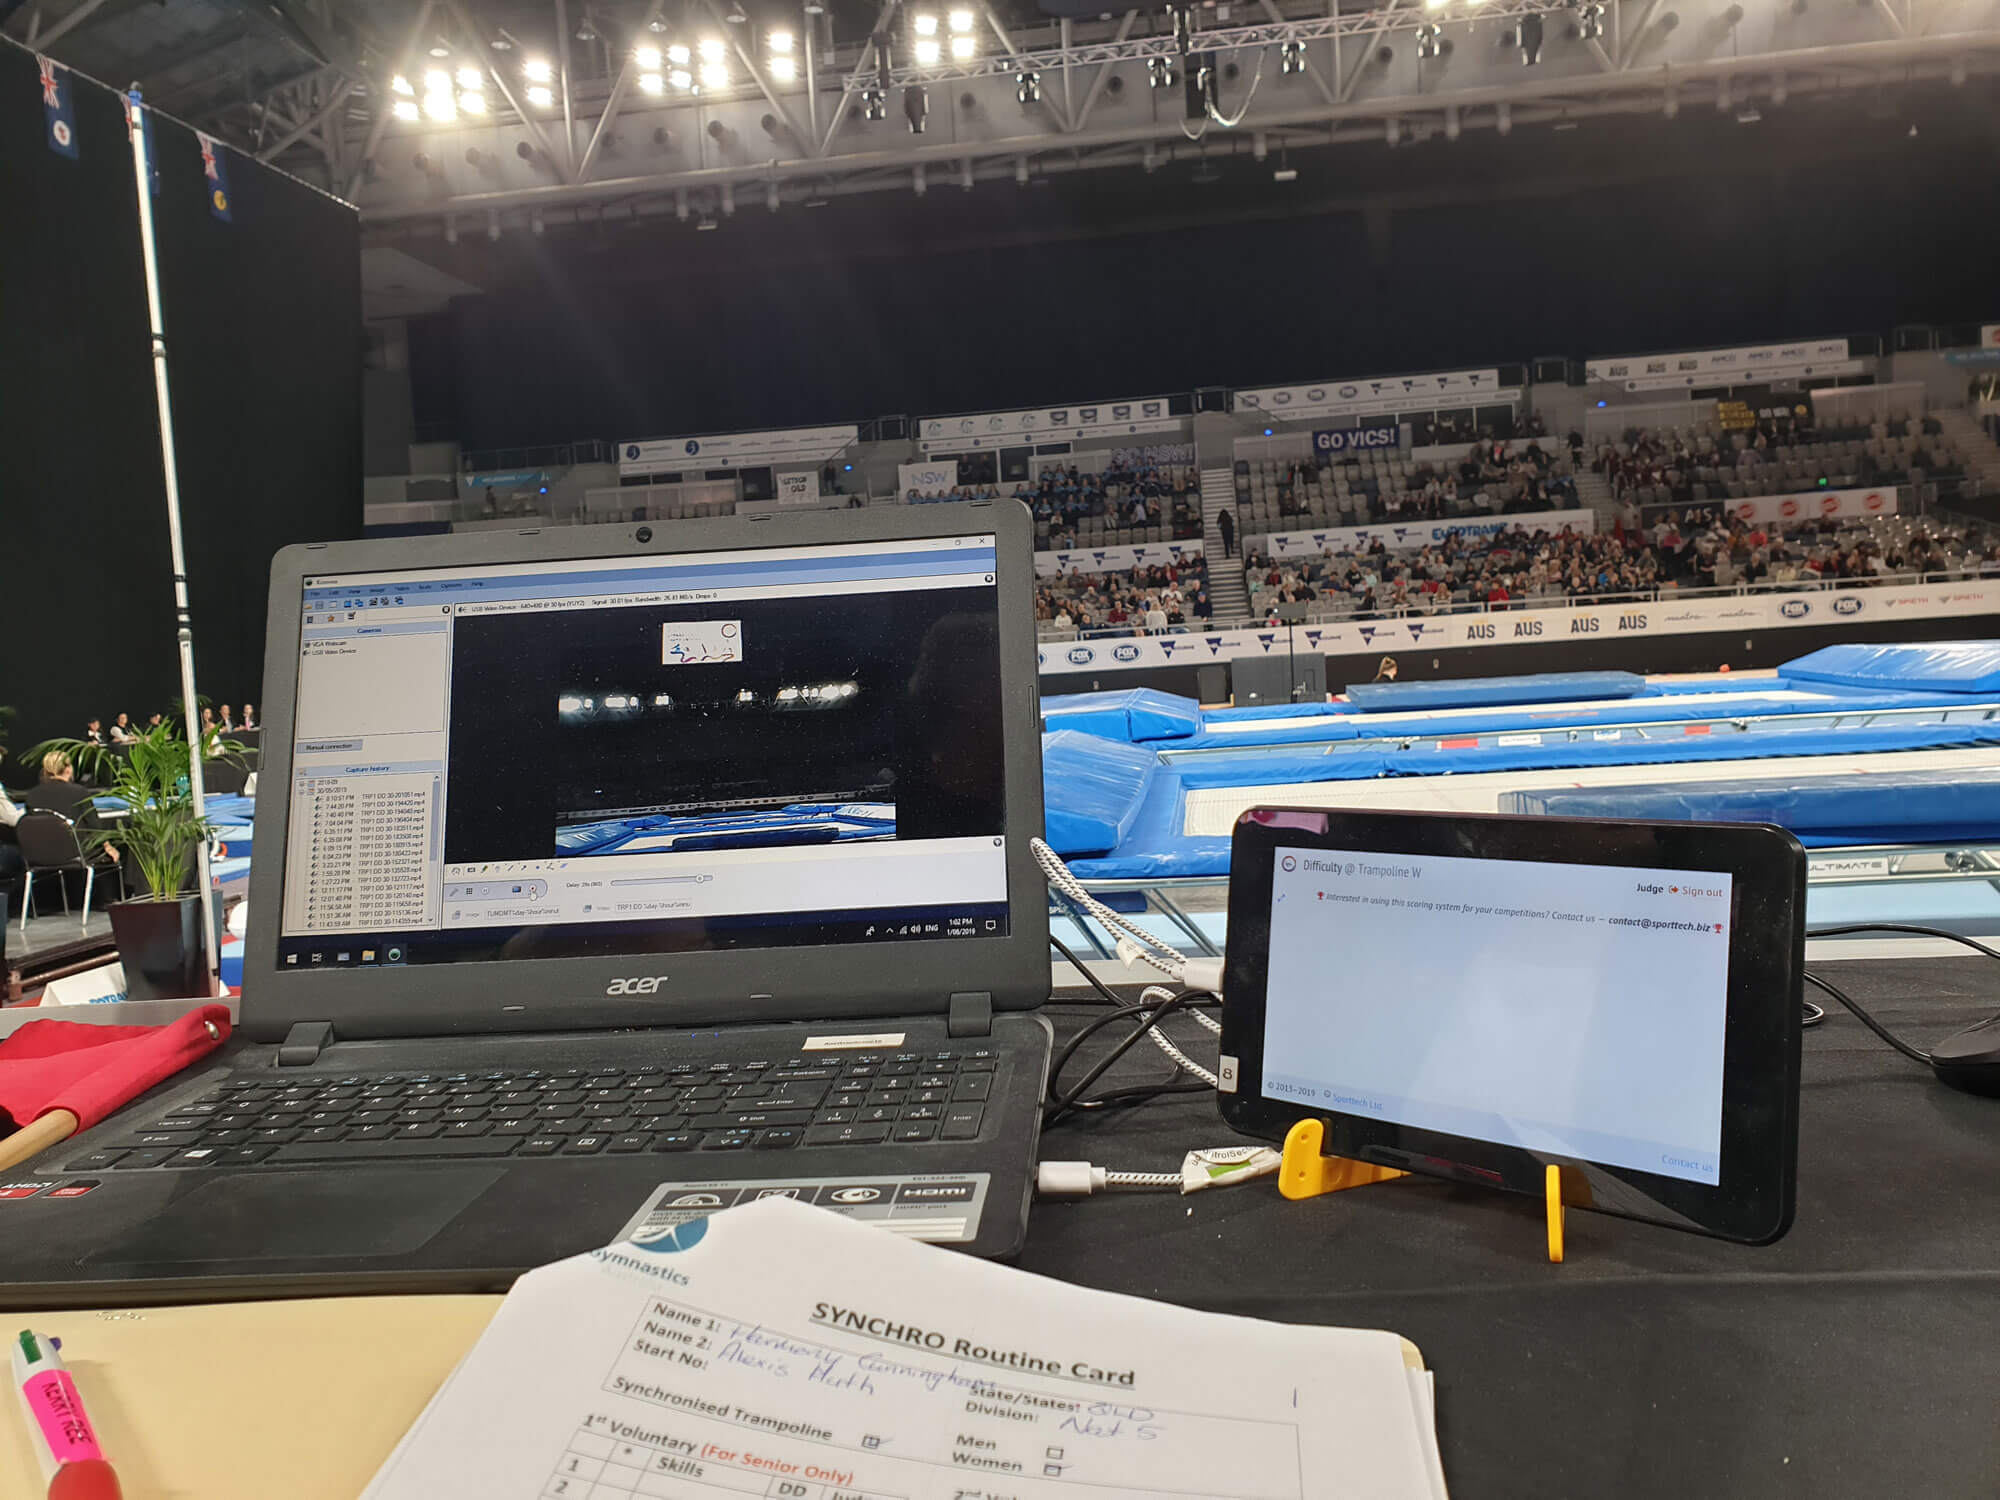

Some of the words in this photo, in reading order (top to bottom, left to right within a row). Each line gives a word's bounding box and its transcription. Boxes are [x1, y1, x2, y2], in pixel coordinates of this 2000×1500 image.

[1317, 432, 1343, 449] GO
[1349, 428, 1395, 447] VICS!
[911, 471, 948, 485] NSW
[1467, 624, 1496, 640] AUS
[1514, 621, 1543, 637] AUS
[1570, 617, 1600, 633] AUS
[1618, 615, 1647, 631] AUS
[1303, 859, 1343, 876] Difficulty
[1344, 863, 1355, 876] @
[1358, 863, 1410, 879] Trampoline
[1412, 867, 1422, 878] W
[1636, 883, 1664, 895] Judge
[1682, 886, 1704, 898] Sign
[1706, 888, 1723, 898] out
[1326, 892, 1361, 903] Interested
[1370, 896, 1390, 907] using
[1391, 896, 1405, 907] this
[1406, 899, 1434, 911] scoring
[1434, 902, 1461, 913] system
[1461, 903, 1473, 914] for
[1474, 905, 1493, 915] your
[1494, 907, 1550, 919] competitions?
[1551, 911, 1583, 922] Contact
[1585, 915, 1596, 923] us
[1608, 915, 1711, 933] contact@sporttech.biz
[925, 924, 939, 932] ENG
[606, 976, 668, 995] acer
[1222, 1068, 1233, 1080] 8
[1662, 1154, 1699, 1170] Contact
[1702, 1164, 1713, 1173] us
[653, 1302, 702, 1326] Name
[706, 1318, 722, 1333] 1:
[643, 1320, 693, 1346] Name
[697, 1335, 713, 1351] 2:
[811, 1301, 946, 1350] SYNCHRO
[953, 1338, 1063, 1375] Routine
[1070, 1362, 1136, 1387] Card
[632, 1338, 675, 1362] Start
[678, 1349, 709, 1371] No:
[611, 1375, 731, 1418] Synchronised
[734, 1408, 833, 1440] Trampoline
[969, 1384, 1081, 1413] State/States:
[965, 1400, 1040, 1424] Division:
[583, 1413, 608, 1428] 1st
[609, 1418, 698, 1455] Voluntary
[699, 1442, 737, 1462] (For
[741, 1452, 801, 1475] Senior
[803, 1463, 855, 1487] Only)
[955, 1433, 998, 1449] Men
[567, 1458, 580, 1472] 1
[657, 1456, 705, 1479] Skills
[951, 1450, 1024, 1472] Women
[554, 1480, 569, 1494] 2
[778, 1482, 808, 1498] DD
